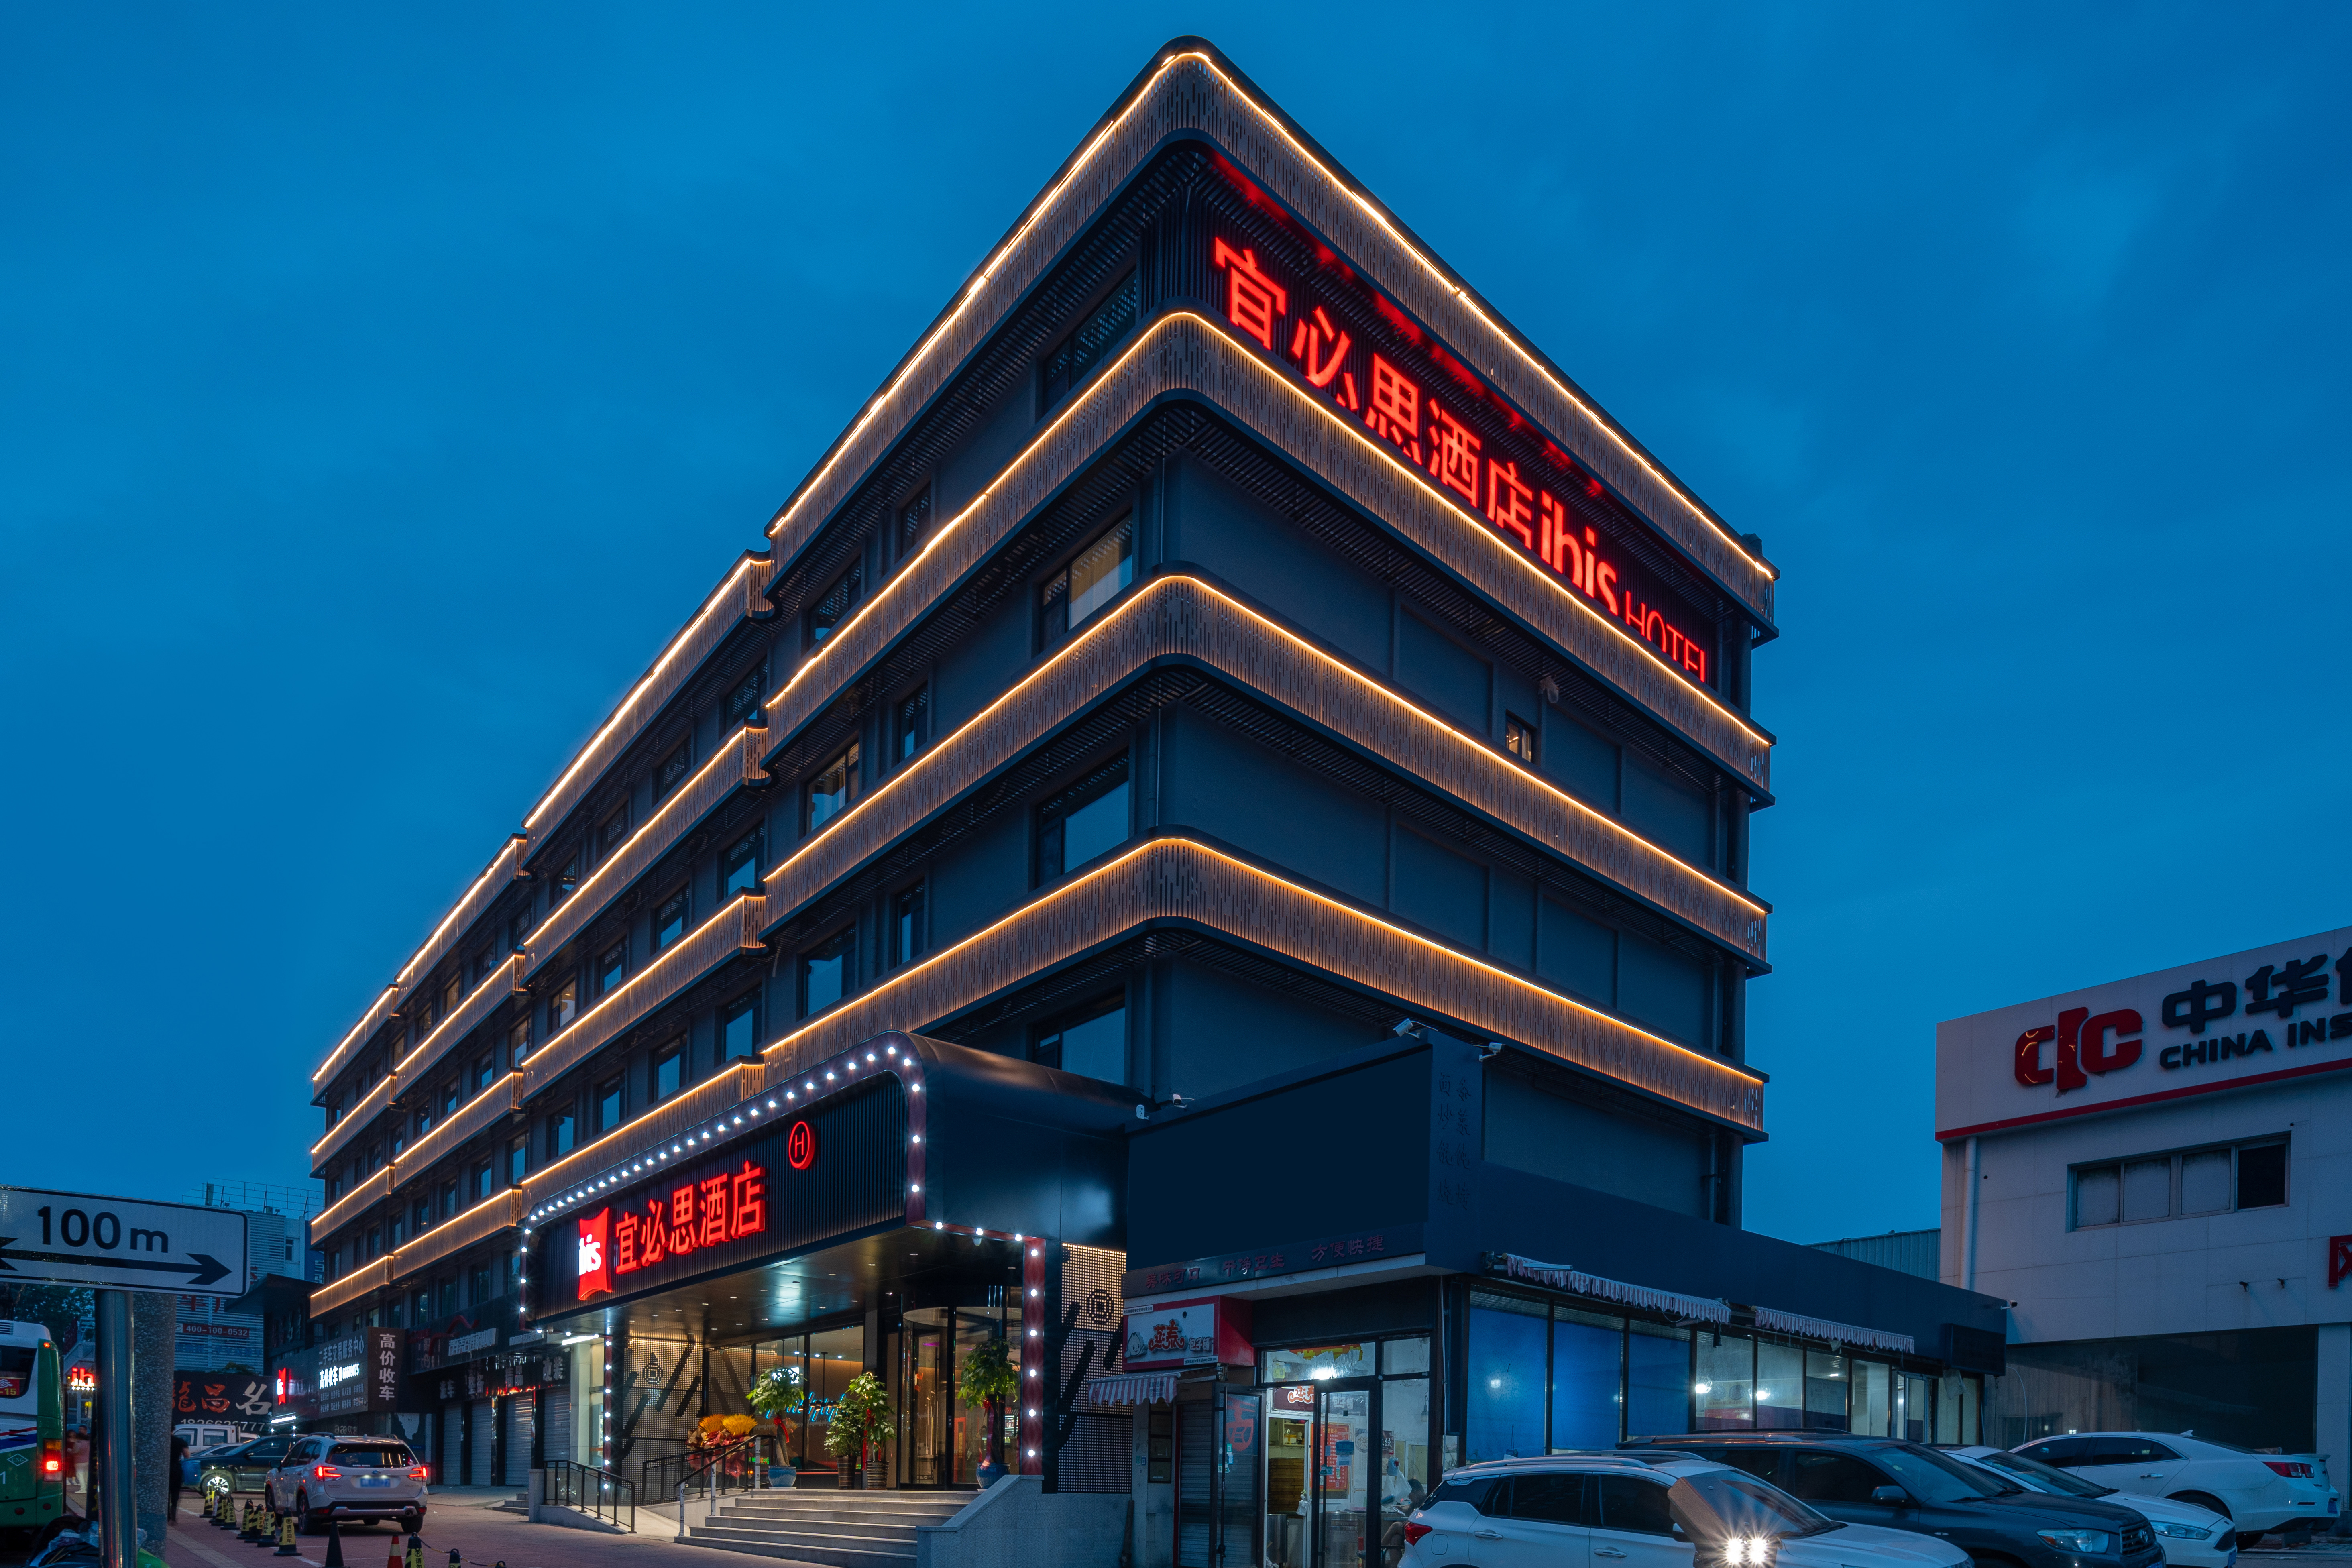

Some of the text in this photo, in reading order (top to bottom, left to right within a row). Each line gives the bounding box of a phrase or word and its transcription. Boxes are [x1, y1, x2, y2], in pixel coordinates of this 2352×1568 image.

[1214, 236, 1532, 550] 宜必思酒店
[2159, 1029, 2273, 1069] CHINA
[38, 1206, 168, 1253] 100 m
[616, 1160, 765, 1275] 宜必思酒店
[1146, 1267, 1200, 1289] 美味可口
[1311, 1234, 1384, 1261] 方便快捷
[186, 1325, 248, 1336] 400-100-0532
[318, 1335, 364, 1365] 二手车交易服务中心
[379, 1333, 396, 1401] 高价收车
